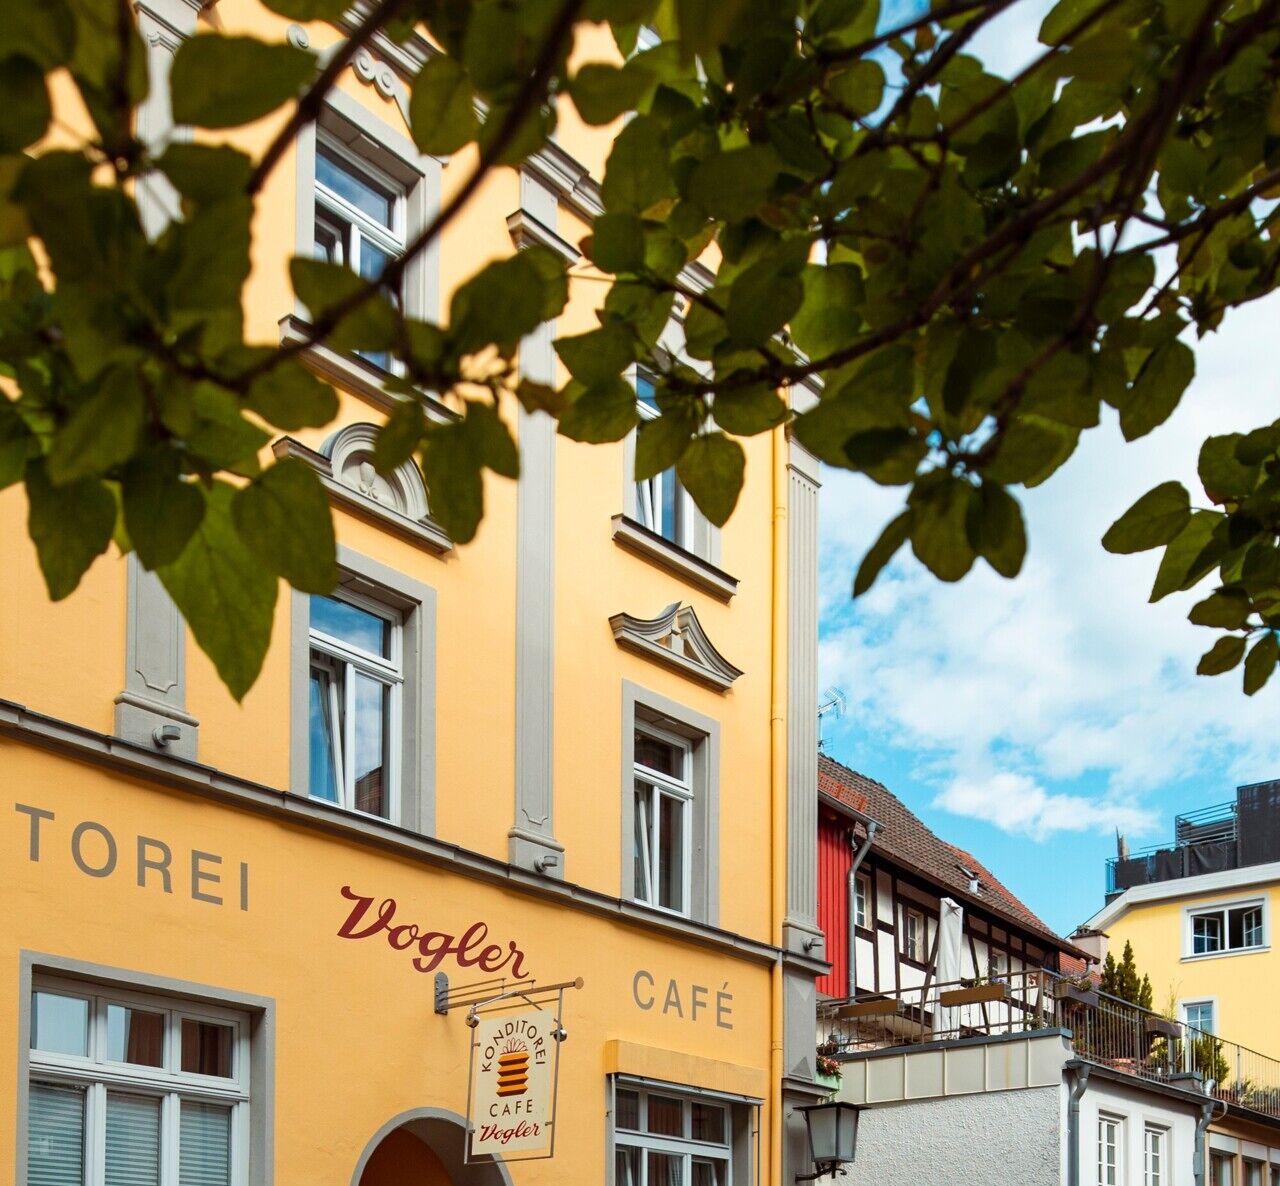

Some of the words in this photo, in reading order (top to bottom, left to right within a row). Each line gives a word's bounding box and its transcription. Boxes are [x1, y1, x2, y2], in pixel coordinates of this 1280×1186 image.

[336, 885, 530, 979] Vogler
[631, 968, 734, 1031] CAFÉ
[481, 1020, 546, 1073] KONDITOREI
[479, 1120, 541, 1144] Vogler
[489, 1099, 533, 1118] CAFE
